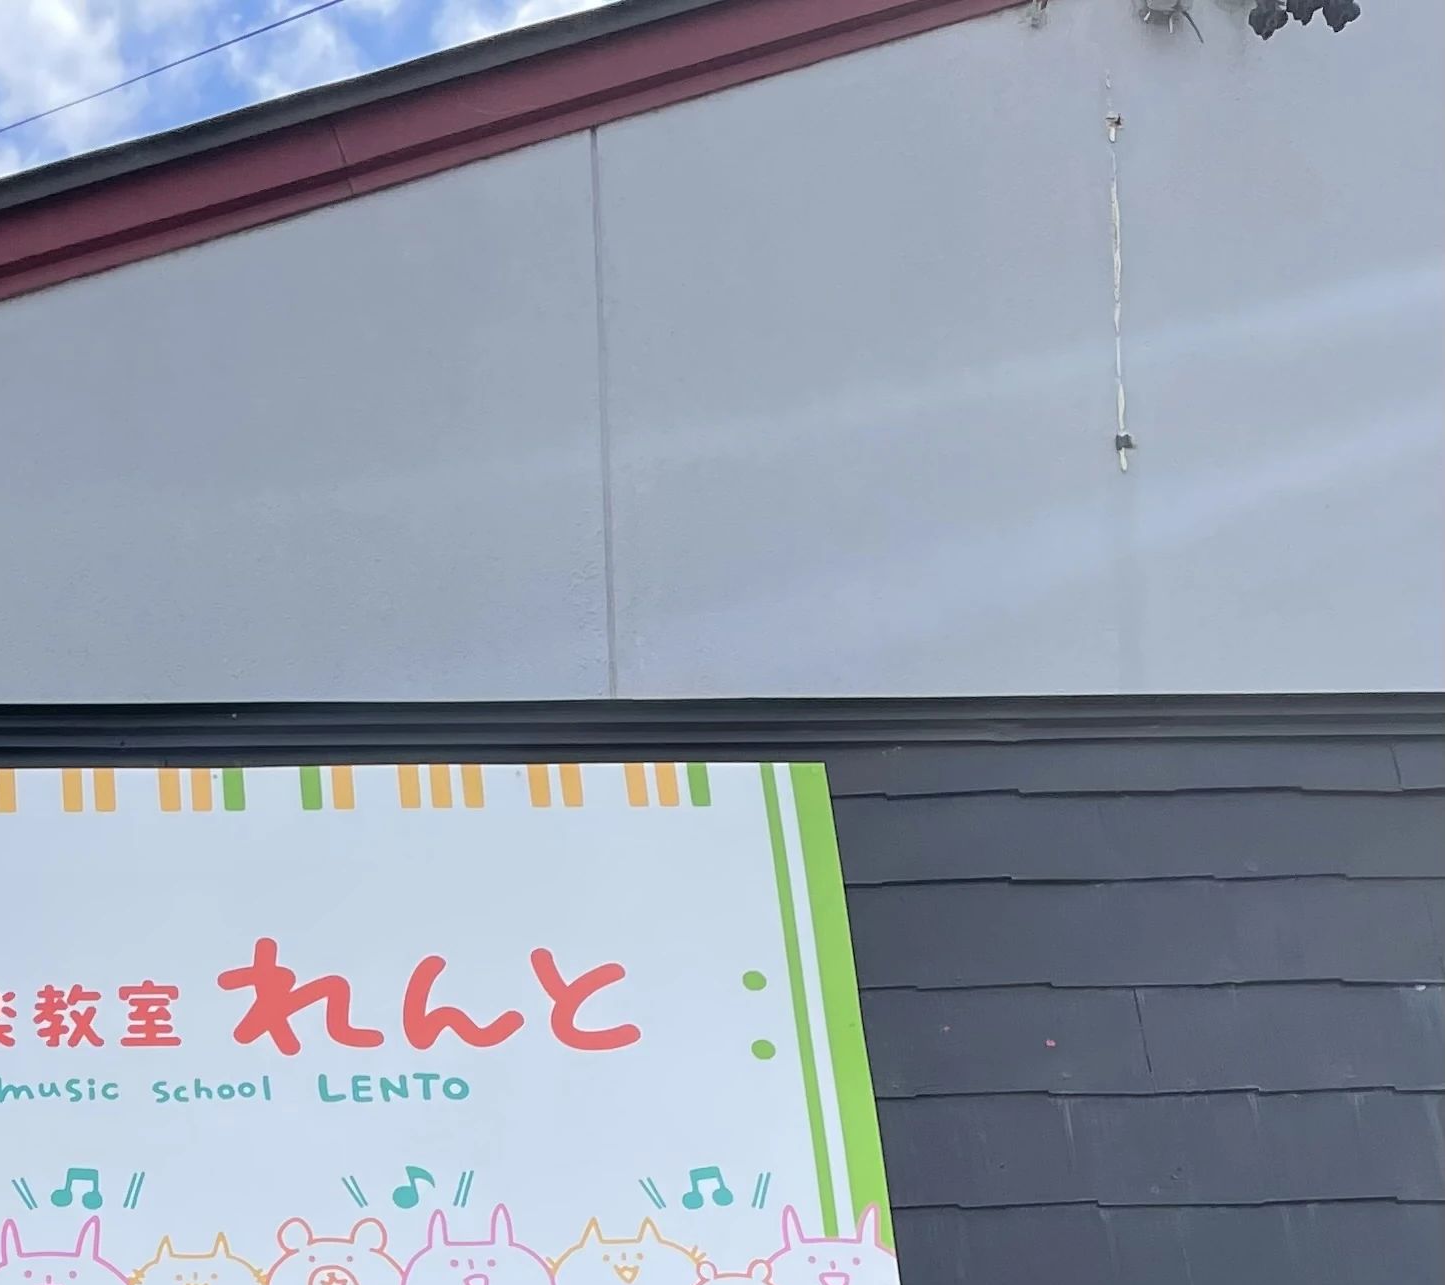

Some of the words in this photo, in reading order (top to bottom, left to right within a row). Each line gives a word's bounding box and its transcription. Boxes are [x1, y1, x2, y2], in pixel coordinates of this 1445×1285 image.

[217, 937, 641, 1056] れんと
[152, 1075, 272, 1104] school
[317, 1072, 471, 1103] LENTO
